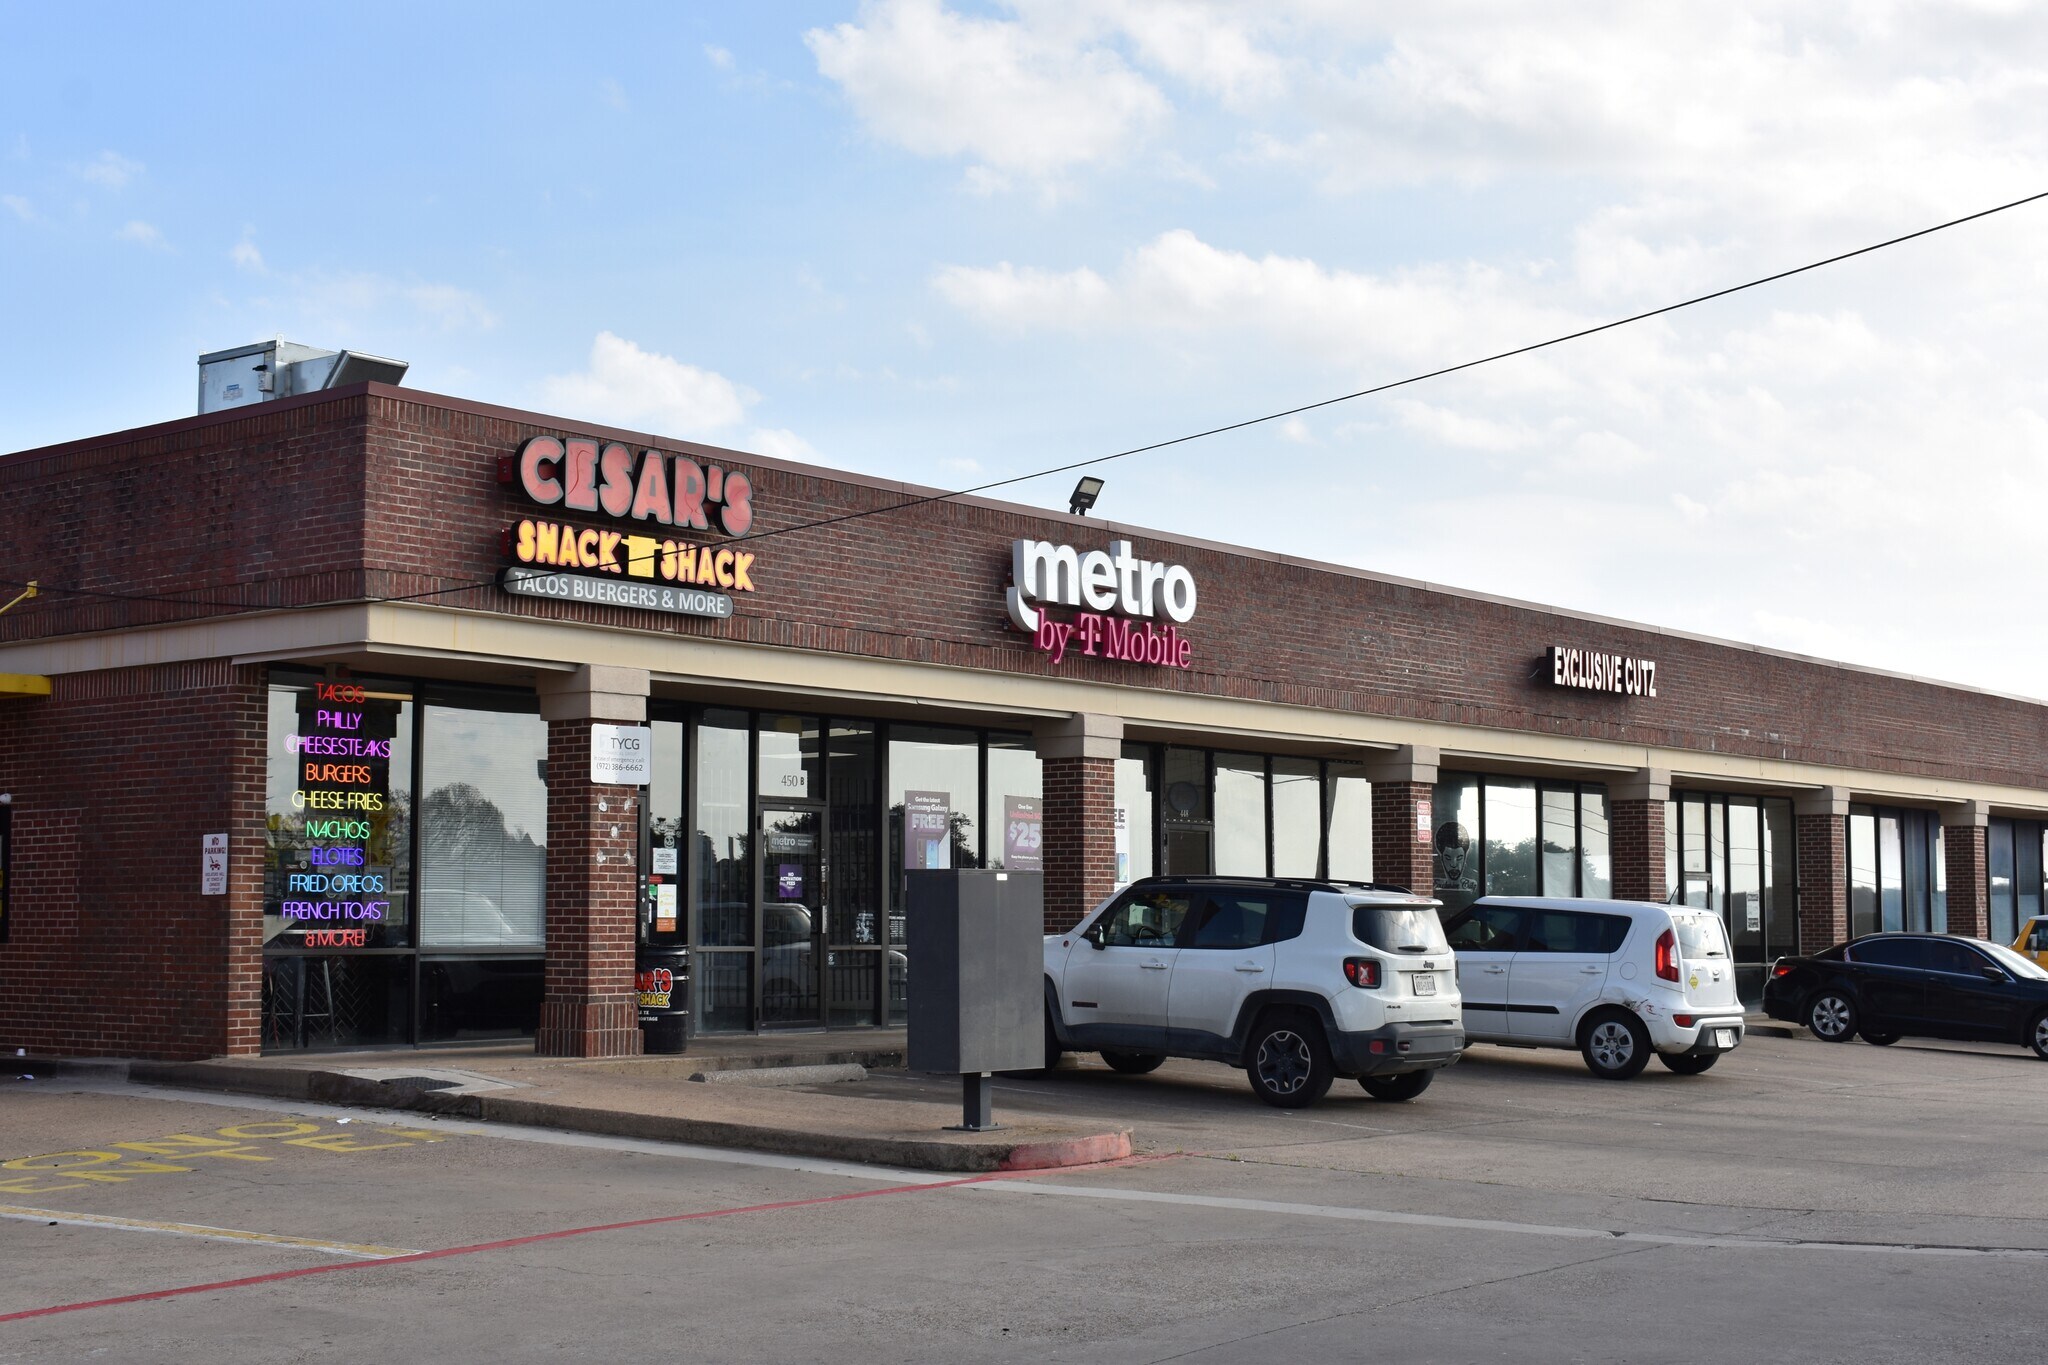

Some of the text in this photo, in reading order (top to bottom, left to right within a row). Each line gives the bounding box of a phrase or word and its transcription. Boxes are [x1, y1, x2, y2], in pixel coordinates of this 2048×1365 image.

[519, 435, 753, 538] CESAR'S
[516, 519, 755, 592] SNACK SHACK
[515, 571, 725, 614] TACOS BUERGERS & MORE
[1012, 538, 1198, 630] metro
[1039, 607, 1073, 665] by
[1554, 646, 1657, 698] EXCLUSIVE CUTZ
[315, 682, 365, 704] TACOS
[317, 709, 363, 730] PHILLY
[284, 733, 392, 759] CHEESESTEAKS
[610, 737, 640, 750] TYCG
[305, 762, 371, 784] BURGERS
[611, 763, 643, 771] 386-6662
[781, 775, 798, 787] 450
[291, 789, 383, 811] CHEESE FRIES
[930, 804, 949, 813] Galaxy
[306, 820, 371, 839] NACHOS
[911, 813, 945, 830] FREE
[771, 836, 796, 846] metro
[1009, 821, 1041, 849] $25
[311, 847, 364, 866] ELOTES
[289, 874, 329, 893] FRIED
[331, 874, 384, 893] OREOS
[282, 901, 390, 921] FRENCH TOAST
[305, 930, 315, 947] &
[635, 968, 673, 993] AR'S
[640, 992, 670, 1007] SHACK
